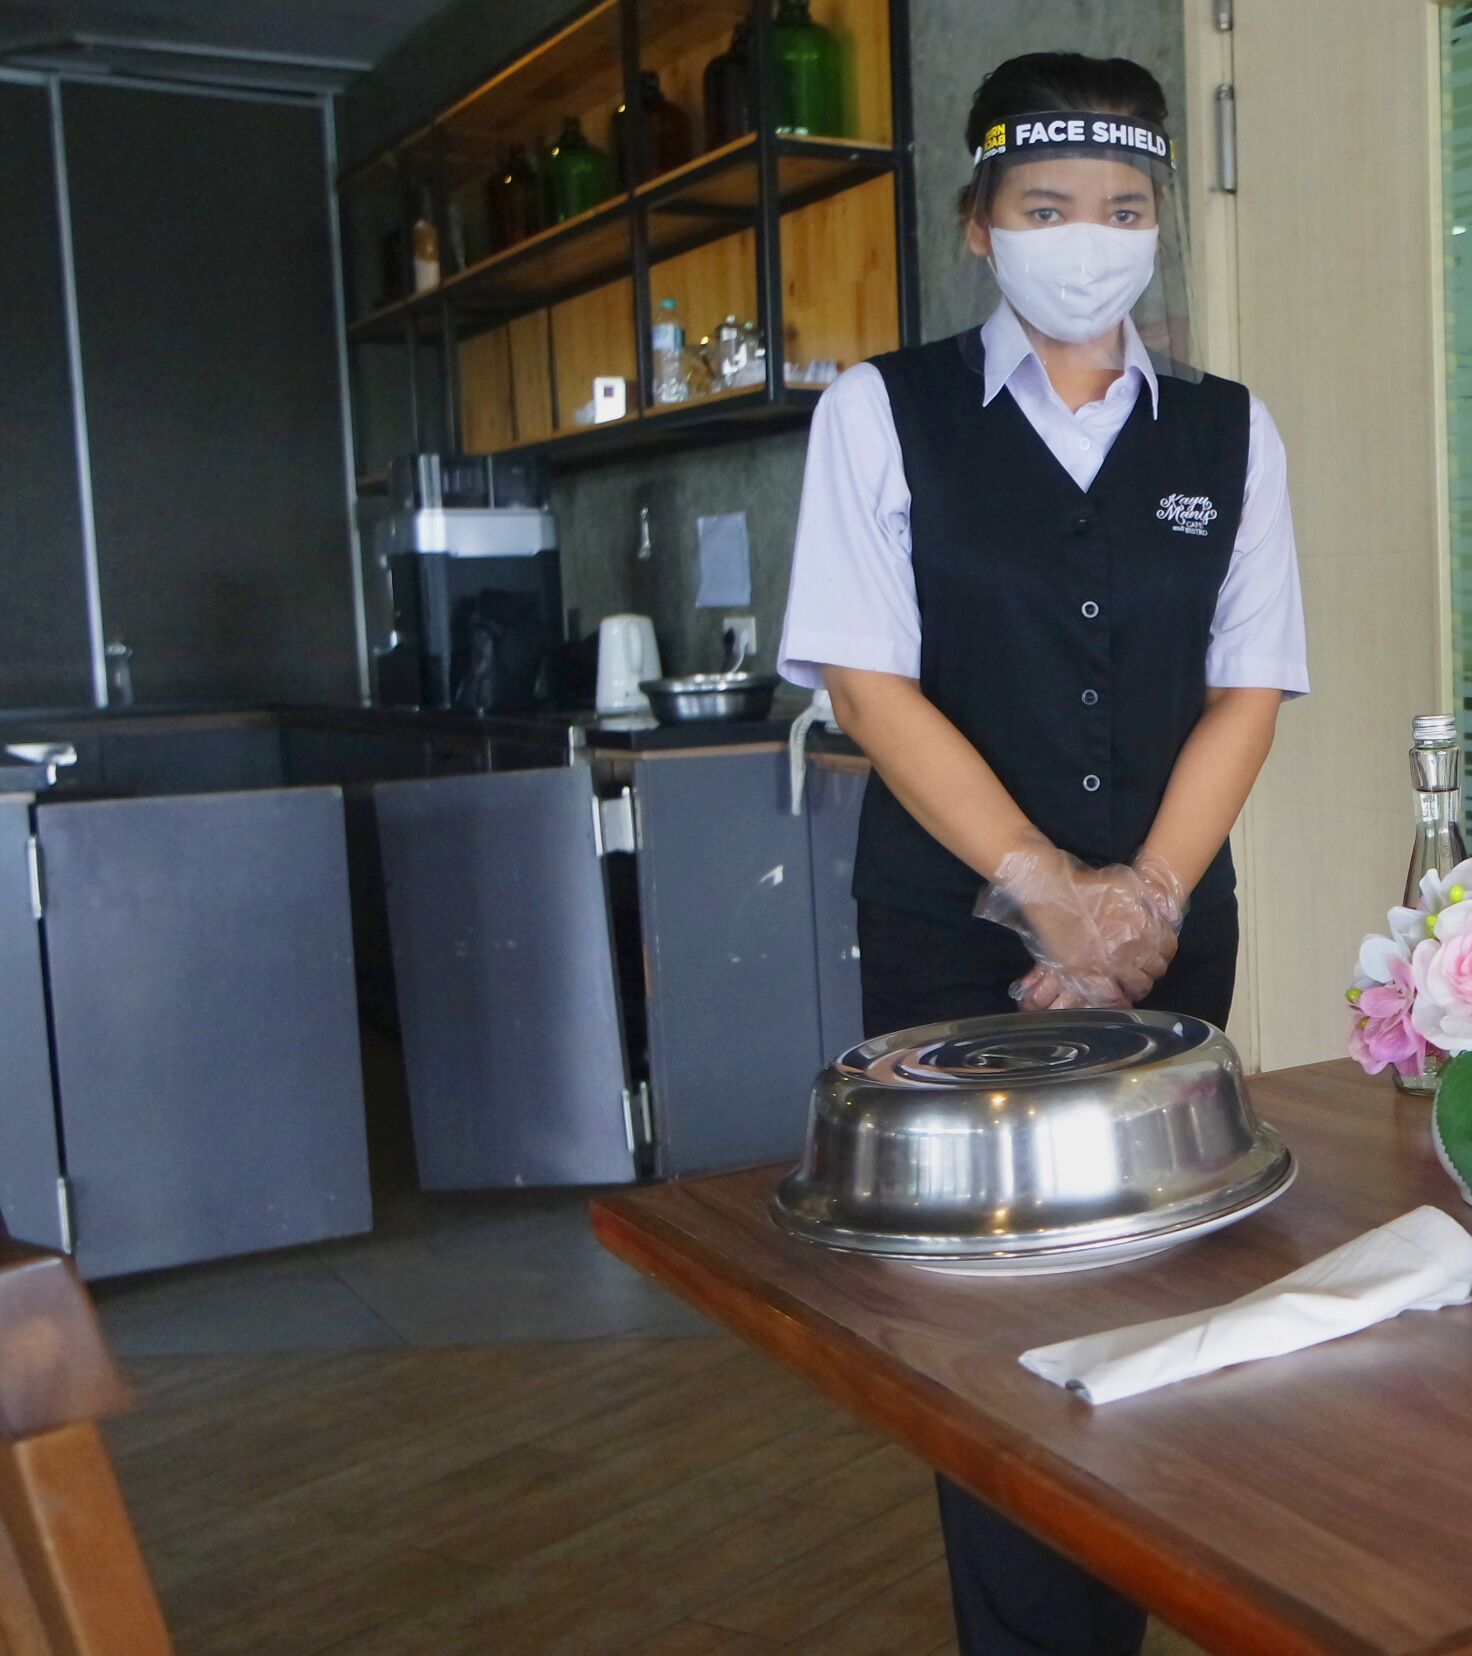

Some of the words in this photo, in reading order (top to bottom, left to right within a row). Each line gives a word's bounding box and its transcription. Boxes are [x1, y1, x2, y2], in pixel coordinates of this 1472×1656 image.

[1015, 120, 1085, 146] FACE
[1092, 121, 1167, 157] SHIELD
[1160, 493, 1213, 512] Kayu
[1156, 504, 1218, 526] Manis
